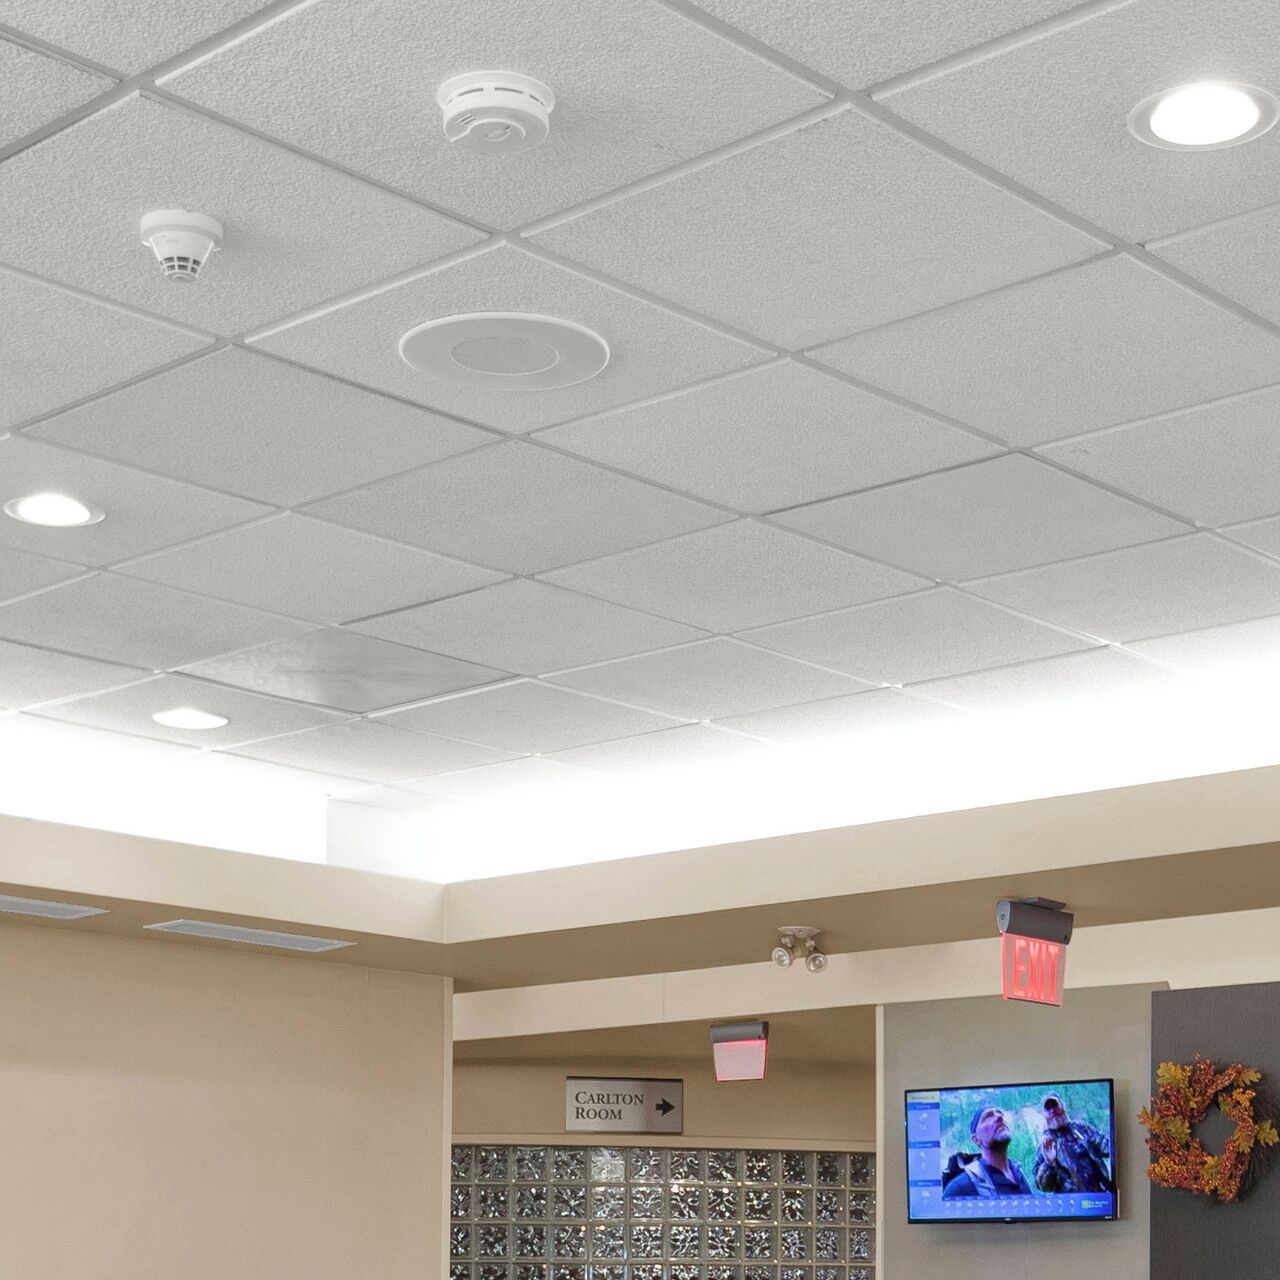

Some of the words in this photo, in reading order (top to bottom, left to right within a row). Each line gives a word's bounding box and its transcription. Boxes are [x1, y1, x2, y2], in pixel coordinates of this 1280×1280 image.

[1014, 938, 1059, 1003] EXIT
[575, 1091, 645, 1105] CARLTON
[575, 1107, 623, 1120] ROOM
